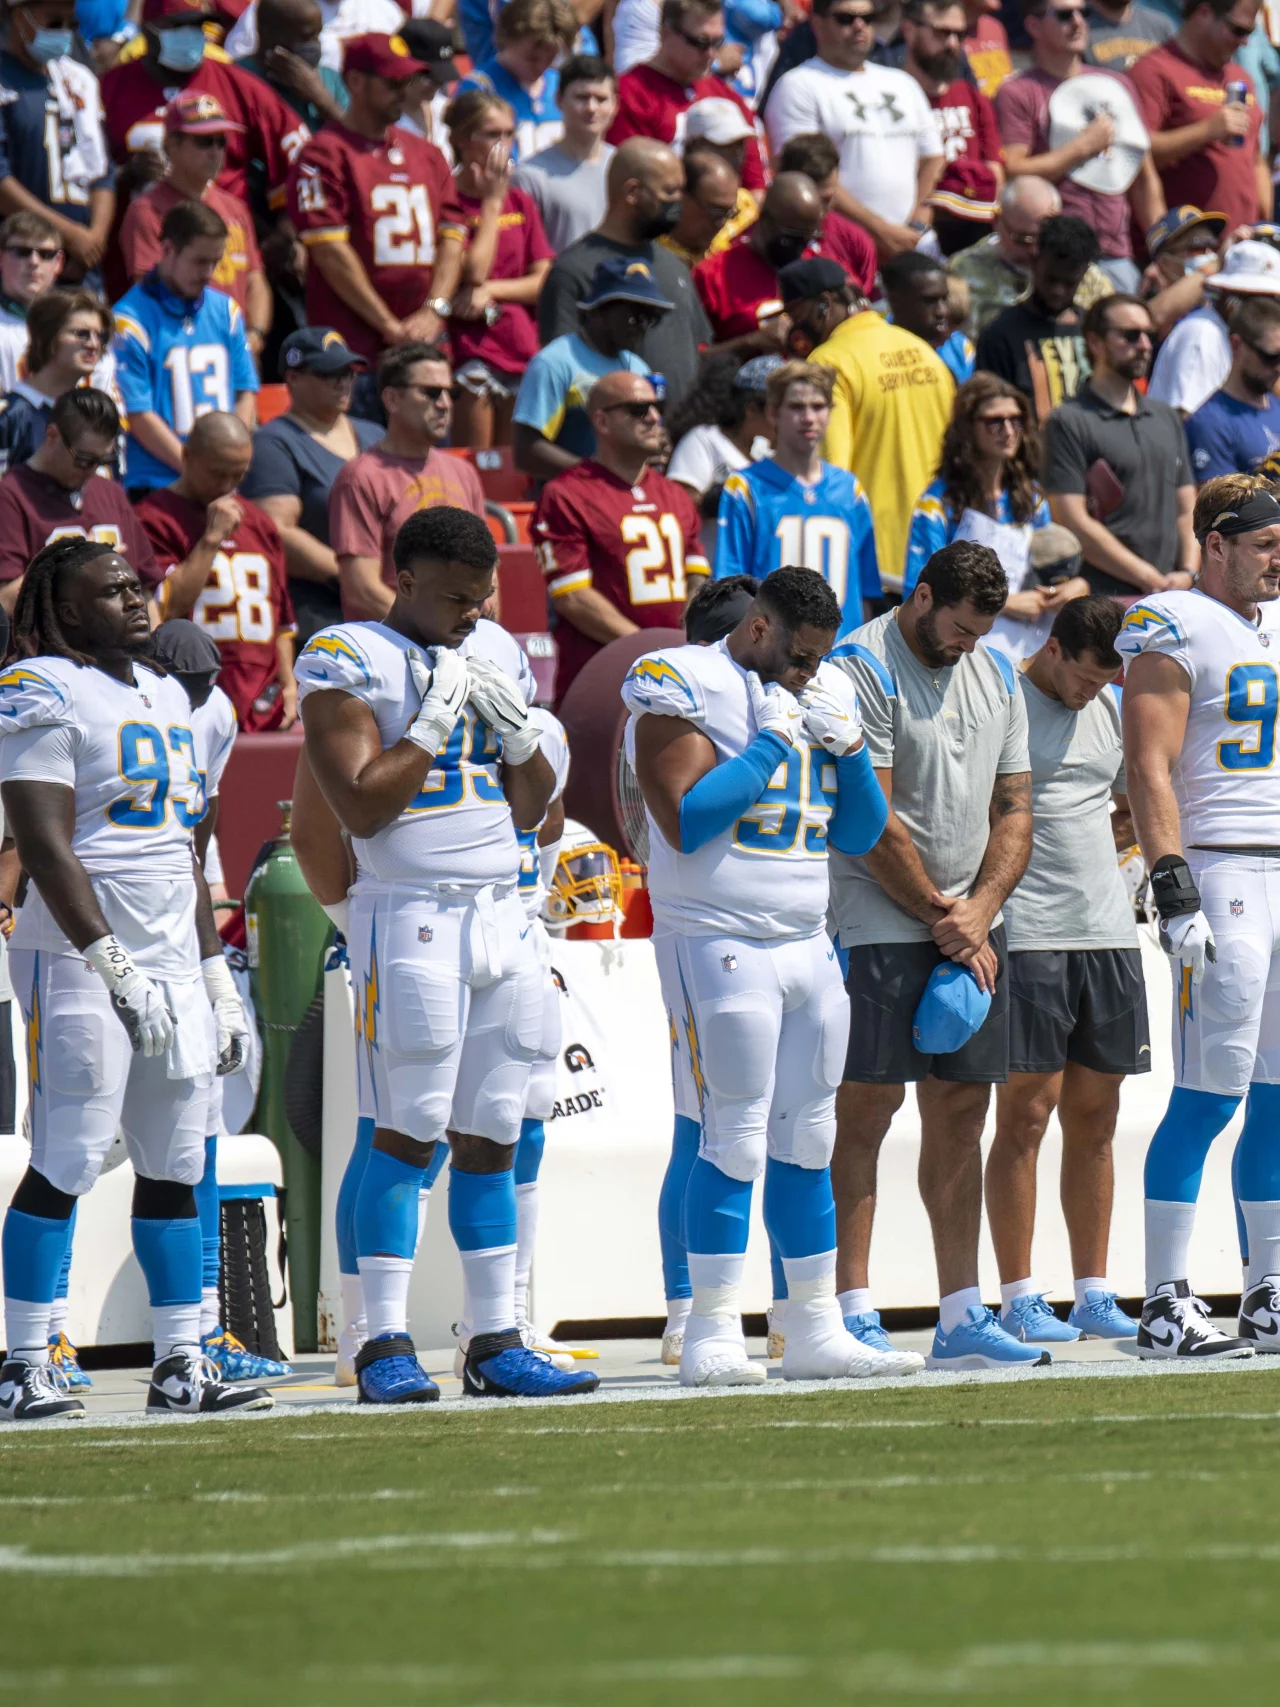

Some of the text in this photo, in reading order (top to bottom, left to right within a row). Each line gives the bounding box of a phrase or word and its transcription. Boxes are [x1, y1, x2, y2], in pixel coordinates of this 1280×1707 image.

[371, 182, 436, 267] 21
[163, 343, 230, 435] 13
[877, 366, 939, 393] SERVICES
[879, 348, 922, 368] GUEST
[193, 551, 275, 644] 28
[621, 512, 687, 606] 21
[774, 515, 850, 606] 10
[105, 719, 208, 831] 93
